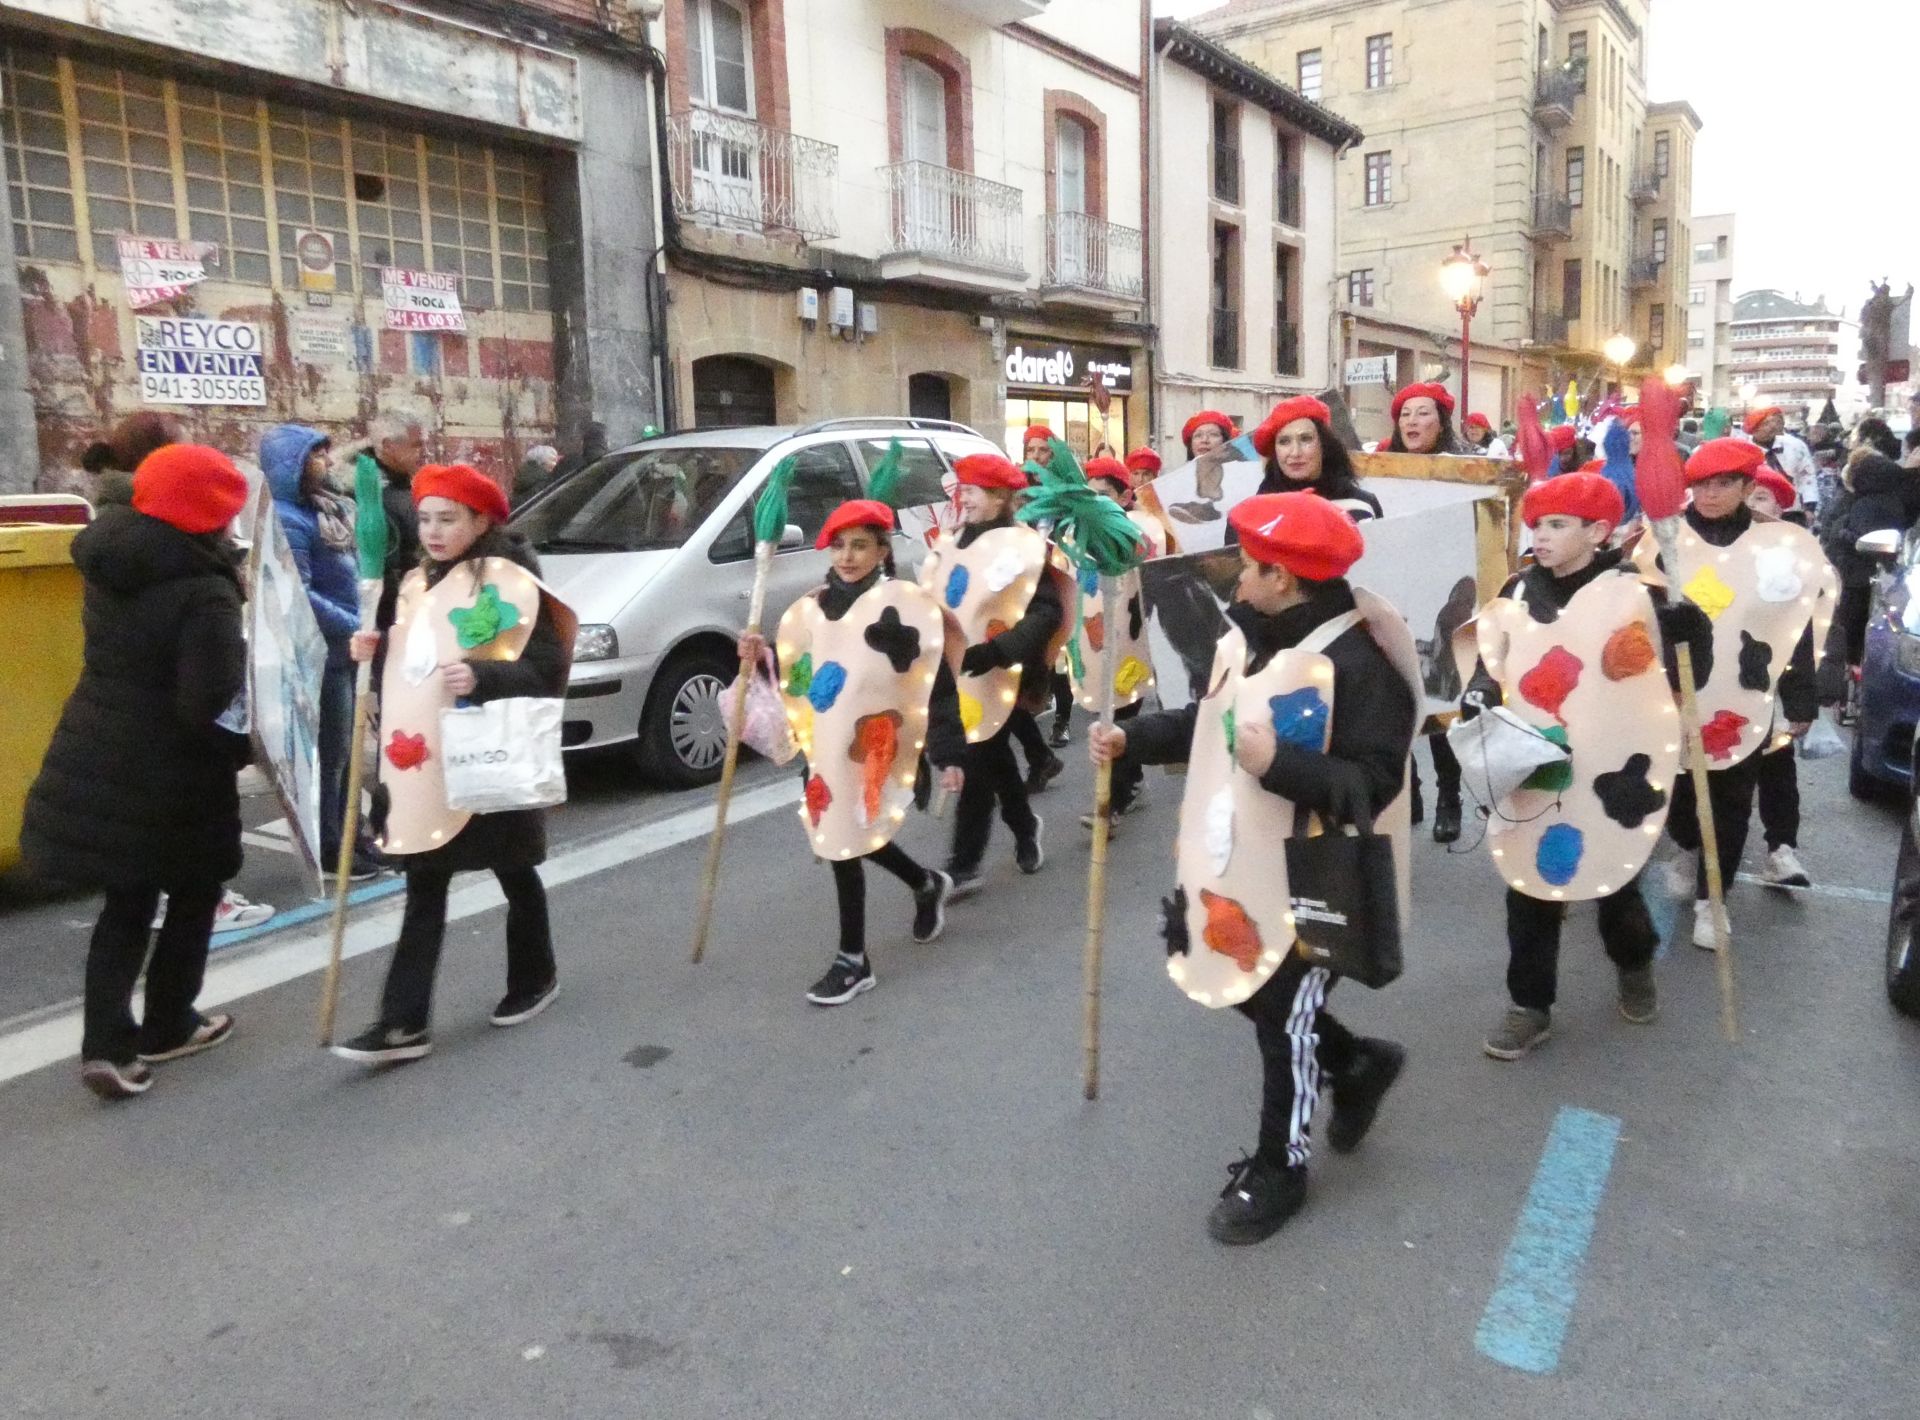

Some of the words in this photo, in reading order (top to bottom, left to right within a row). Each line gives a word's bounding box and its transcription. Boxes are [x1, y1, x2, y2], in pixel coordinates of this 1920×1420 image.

[120, 240, 151, 258] ME
[384, 268, 406, 287] ME
[408, 271, 455, 291] VENDE
[388, 310, 408, 327] 941
[411, 311, 426, 328] 31
[427, 313, 444, 327] 00
[160, 320, 255, 350] REYCO
[142, 350, 177, 373] EN
[180, 352, 260, 377] VENTA
[1006, 346, 1066, 385] clarel
[447, 749, 508, 765] MANGO
